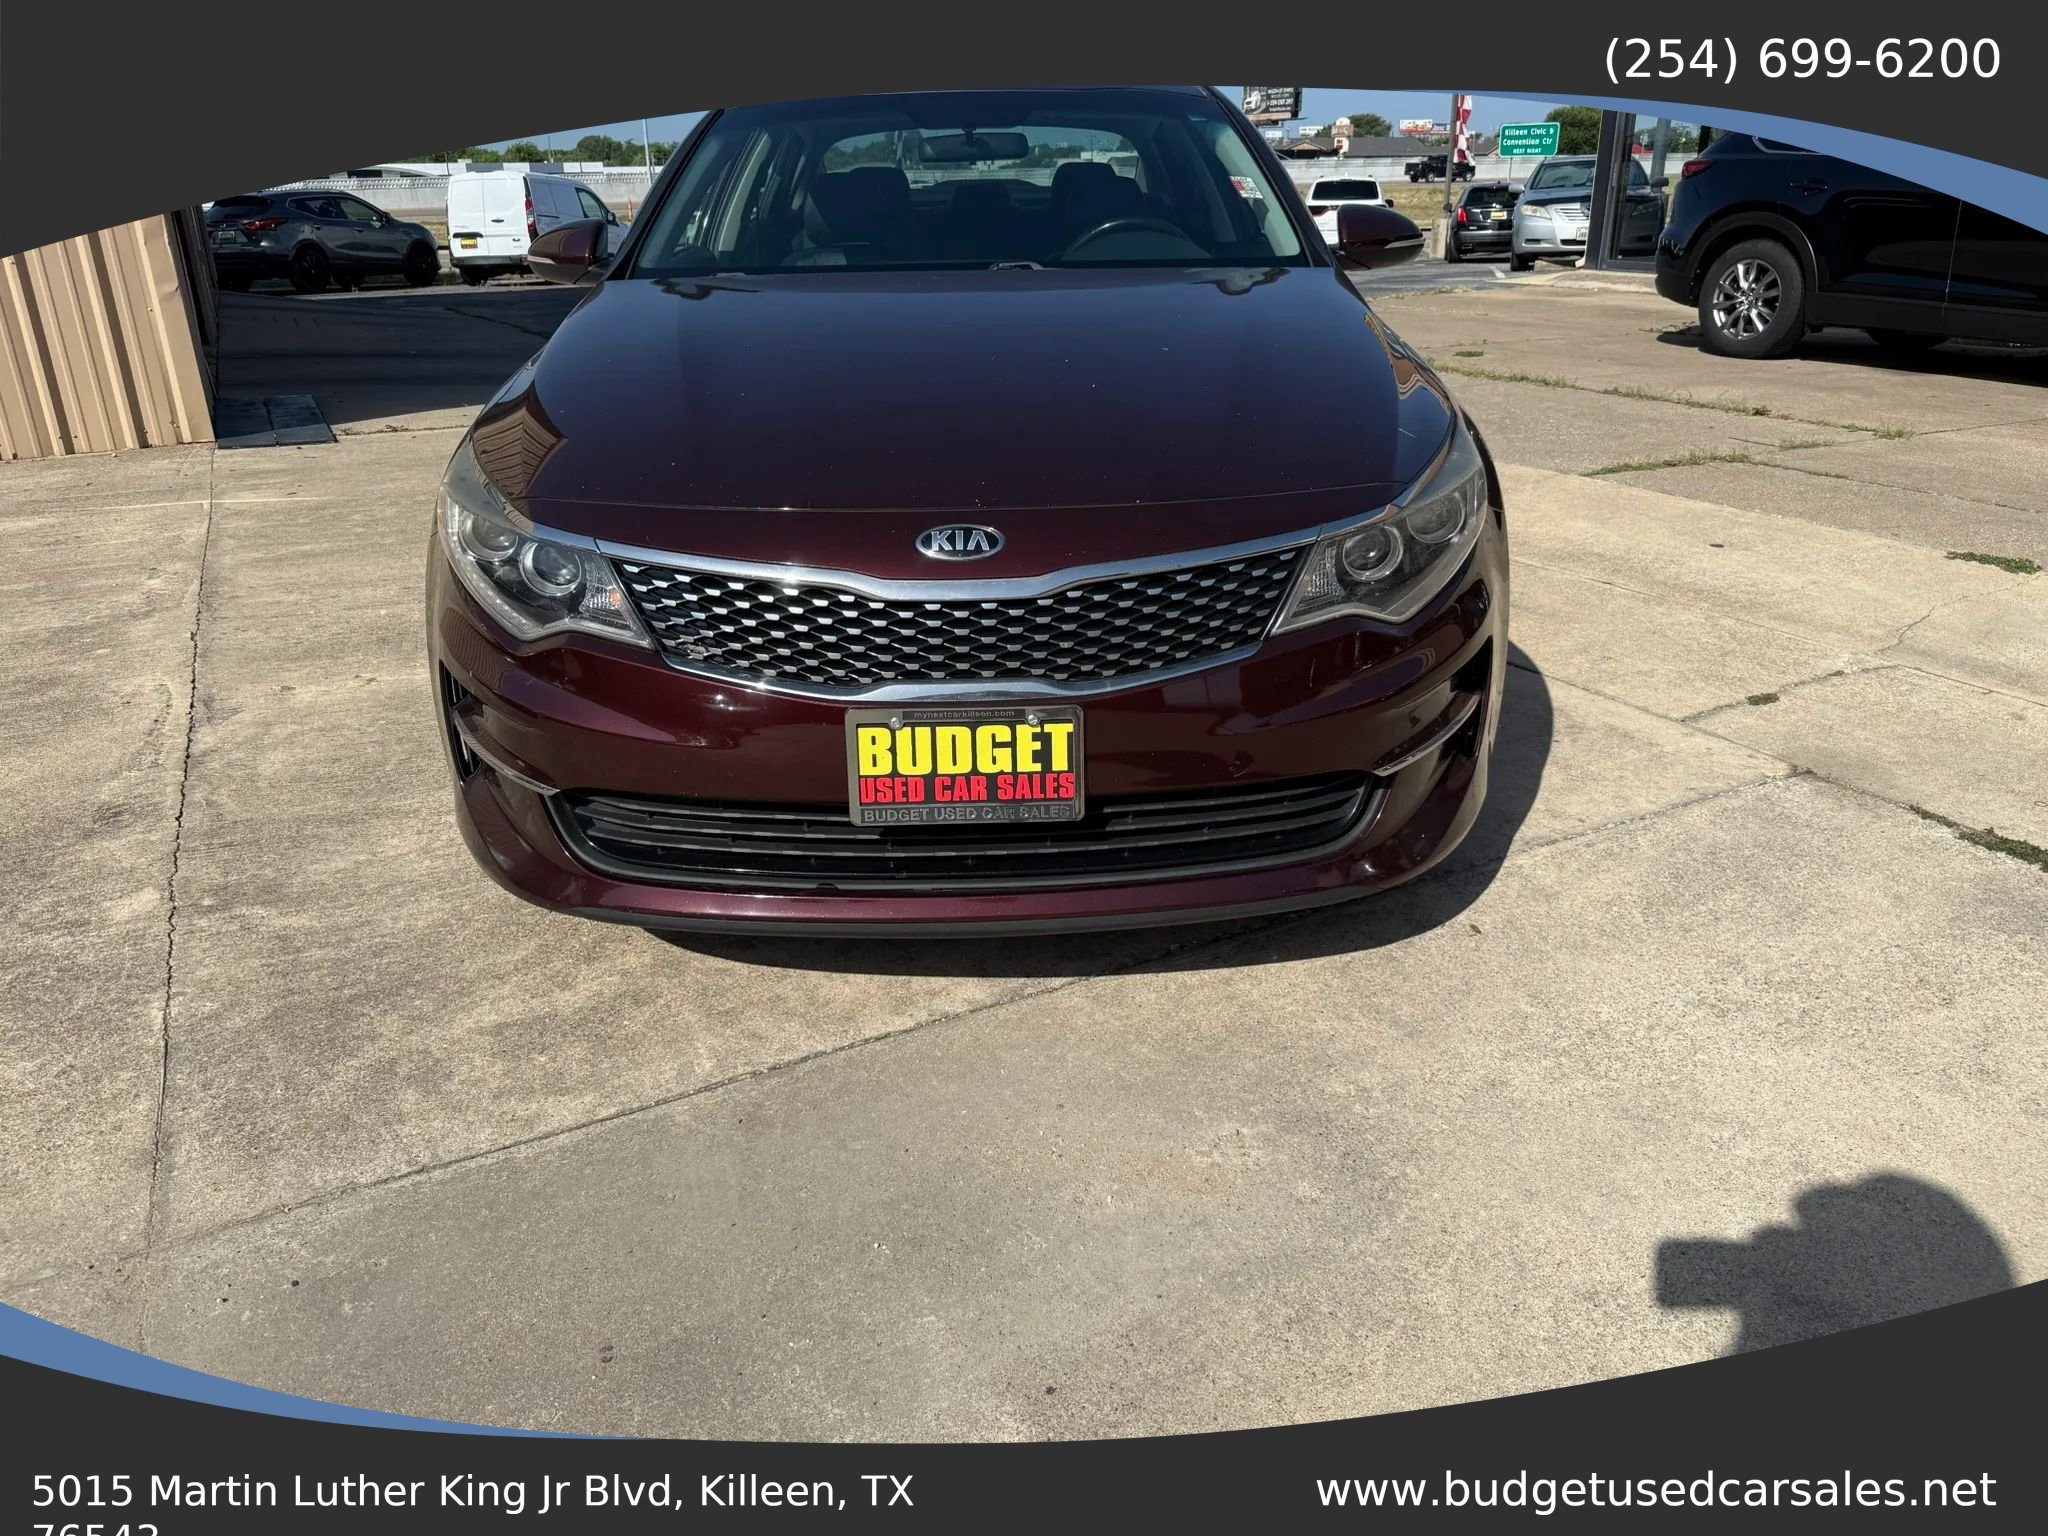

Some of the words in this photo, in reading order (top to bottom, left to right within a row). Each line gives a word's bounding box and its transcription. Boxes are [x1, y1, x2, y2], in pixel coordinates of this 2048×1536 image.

[1504, 128, 1528, 136] Killeen
[1530, 127, 1547, 135] Civic
[931, 530, 990, 551] KIA
[857, 723, 1075, 776] BUDGET
[860, 776, 925, 804] USED
[934, 775, 987, 802] CAR
[997, 773, 1075, 800] SALES
[864, 807, 929, 822] BUDGET
[934, 806, 977, 821] USED
[981, 806, 1015, 820] CAR
[1019, 804, 1070, 819] SALES
